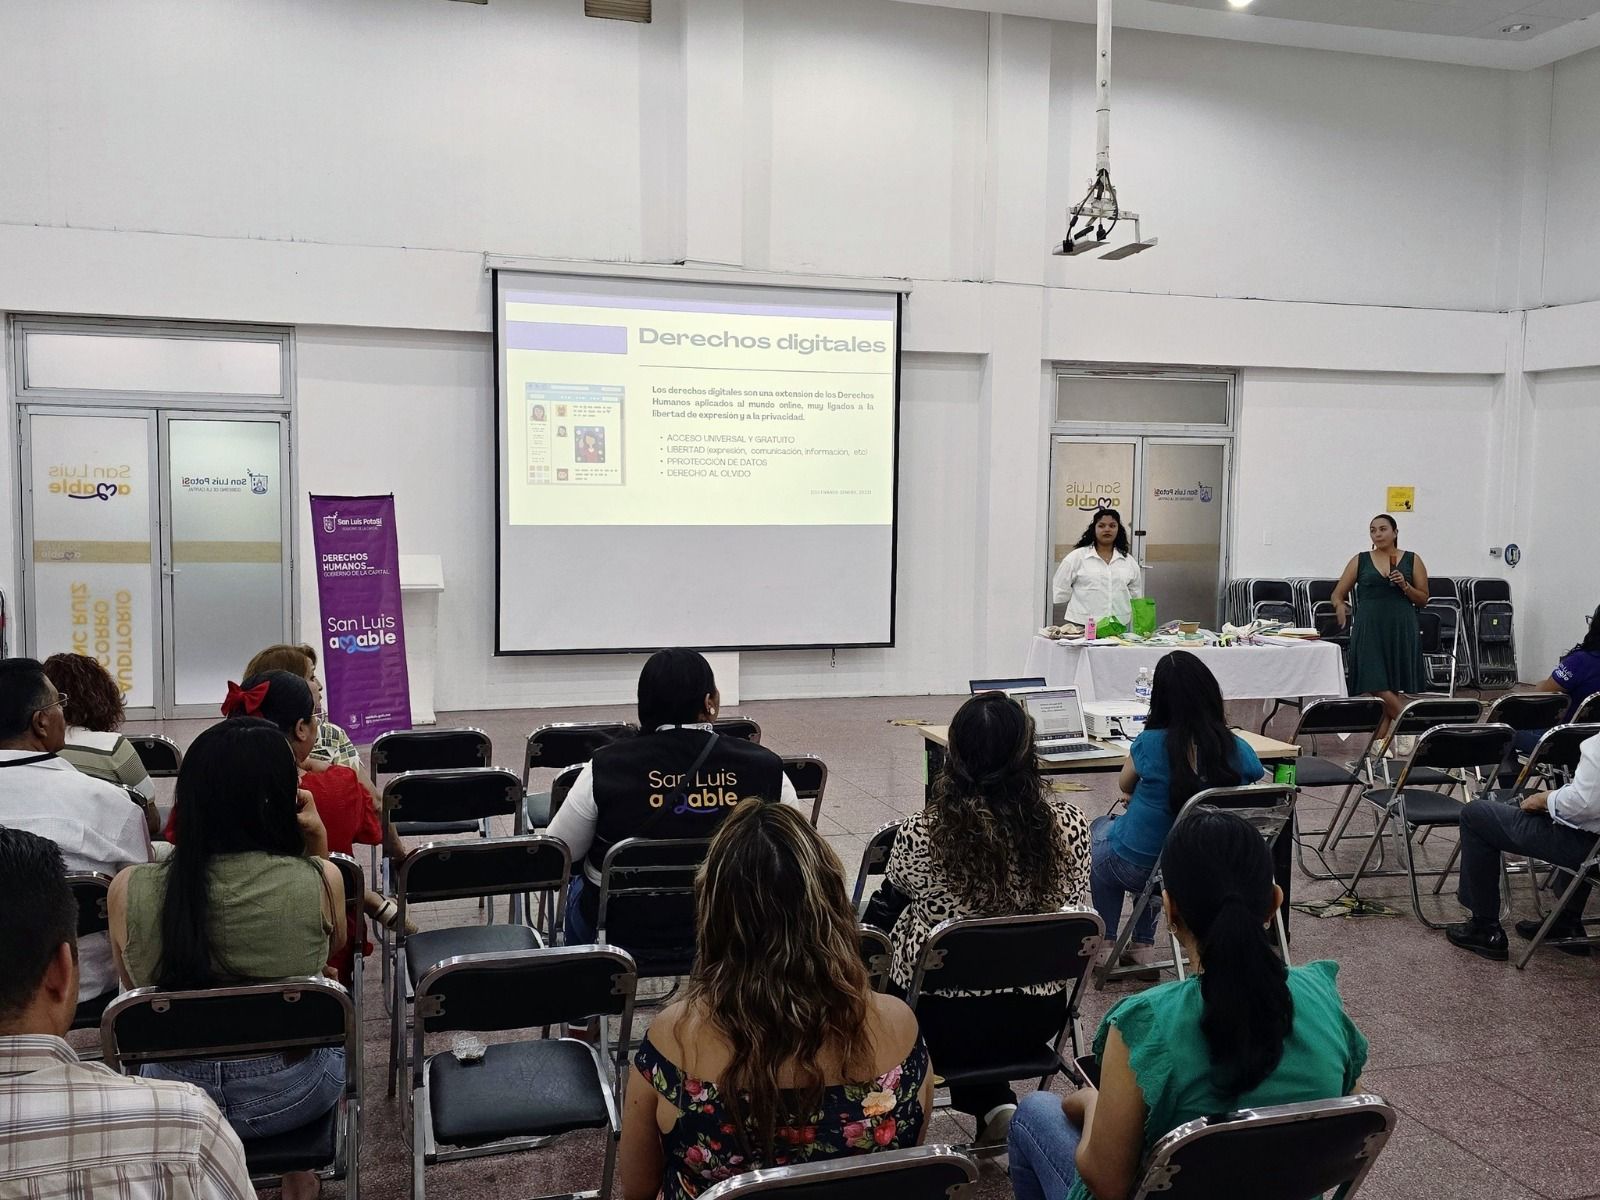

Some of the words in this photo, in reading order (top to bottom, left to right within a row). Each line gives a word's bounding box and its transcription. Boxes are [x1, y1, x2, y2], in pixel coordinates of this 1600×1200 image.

[639, 327, 771, 349] Derechos
[776, 333, 887, 355] digitales
[668, 387, 706, 395] derechos
[708, 388, 742, 397] digitales
[652, 398, 690, 406] Humanos
[695, 399, 733, 408] aplicados
[807, 403, 823, 411] muy
[828, 402, 855, 411] ligados
[699, 411, 738, 420] expresión
[739, 413, 745, 421] y
[667, 434, 701, 442] ACCESO
[704, 434, 746, 443] UNIVERSAL
[727, 458, 738, 466] DE
[667, 469, 707, 477] DERECHO
[709, 469, 718, 477] AL
[322, 553, 368, 562] DERECHOS
[323, 570, 351, 578] GOBIERNO
[328, 617, 358, 632] San
[362, 613, 395, 630] Luis
[696, 768, 737, 787] Luis
